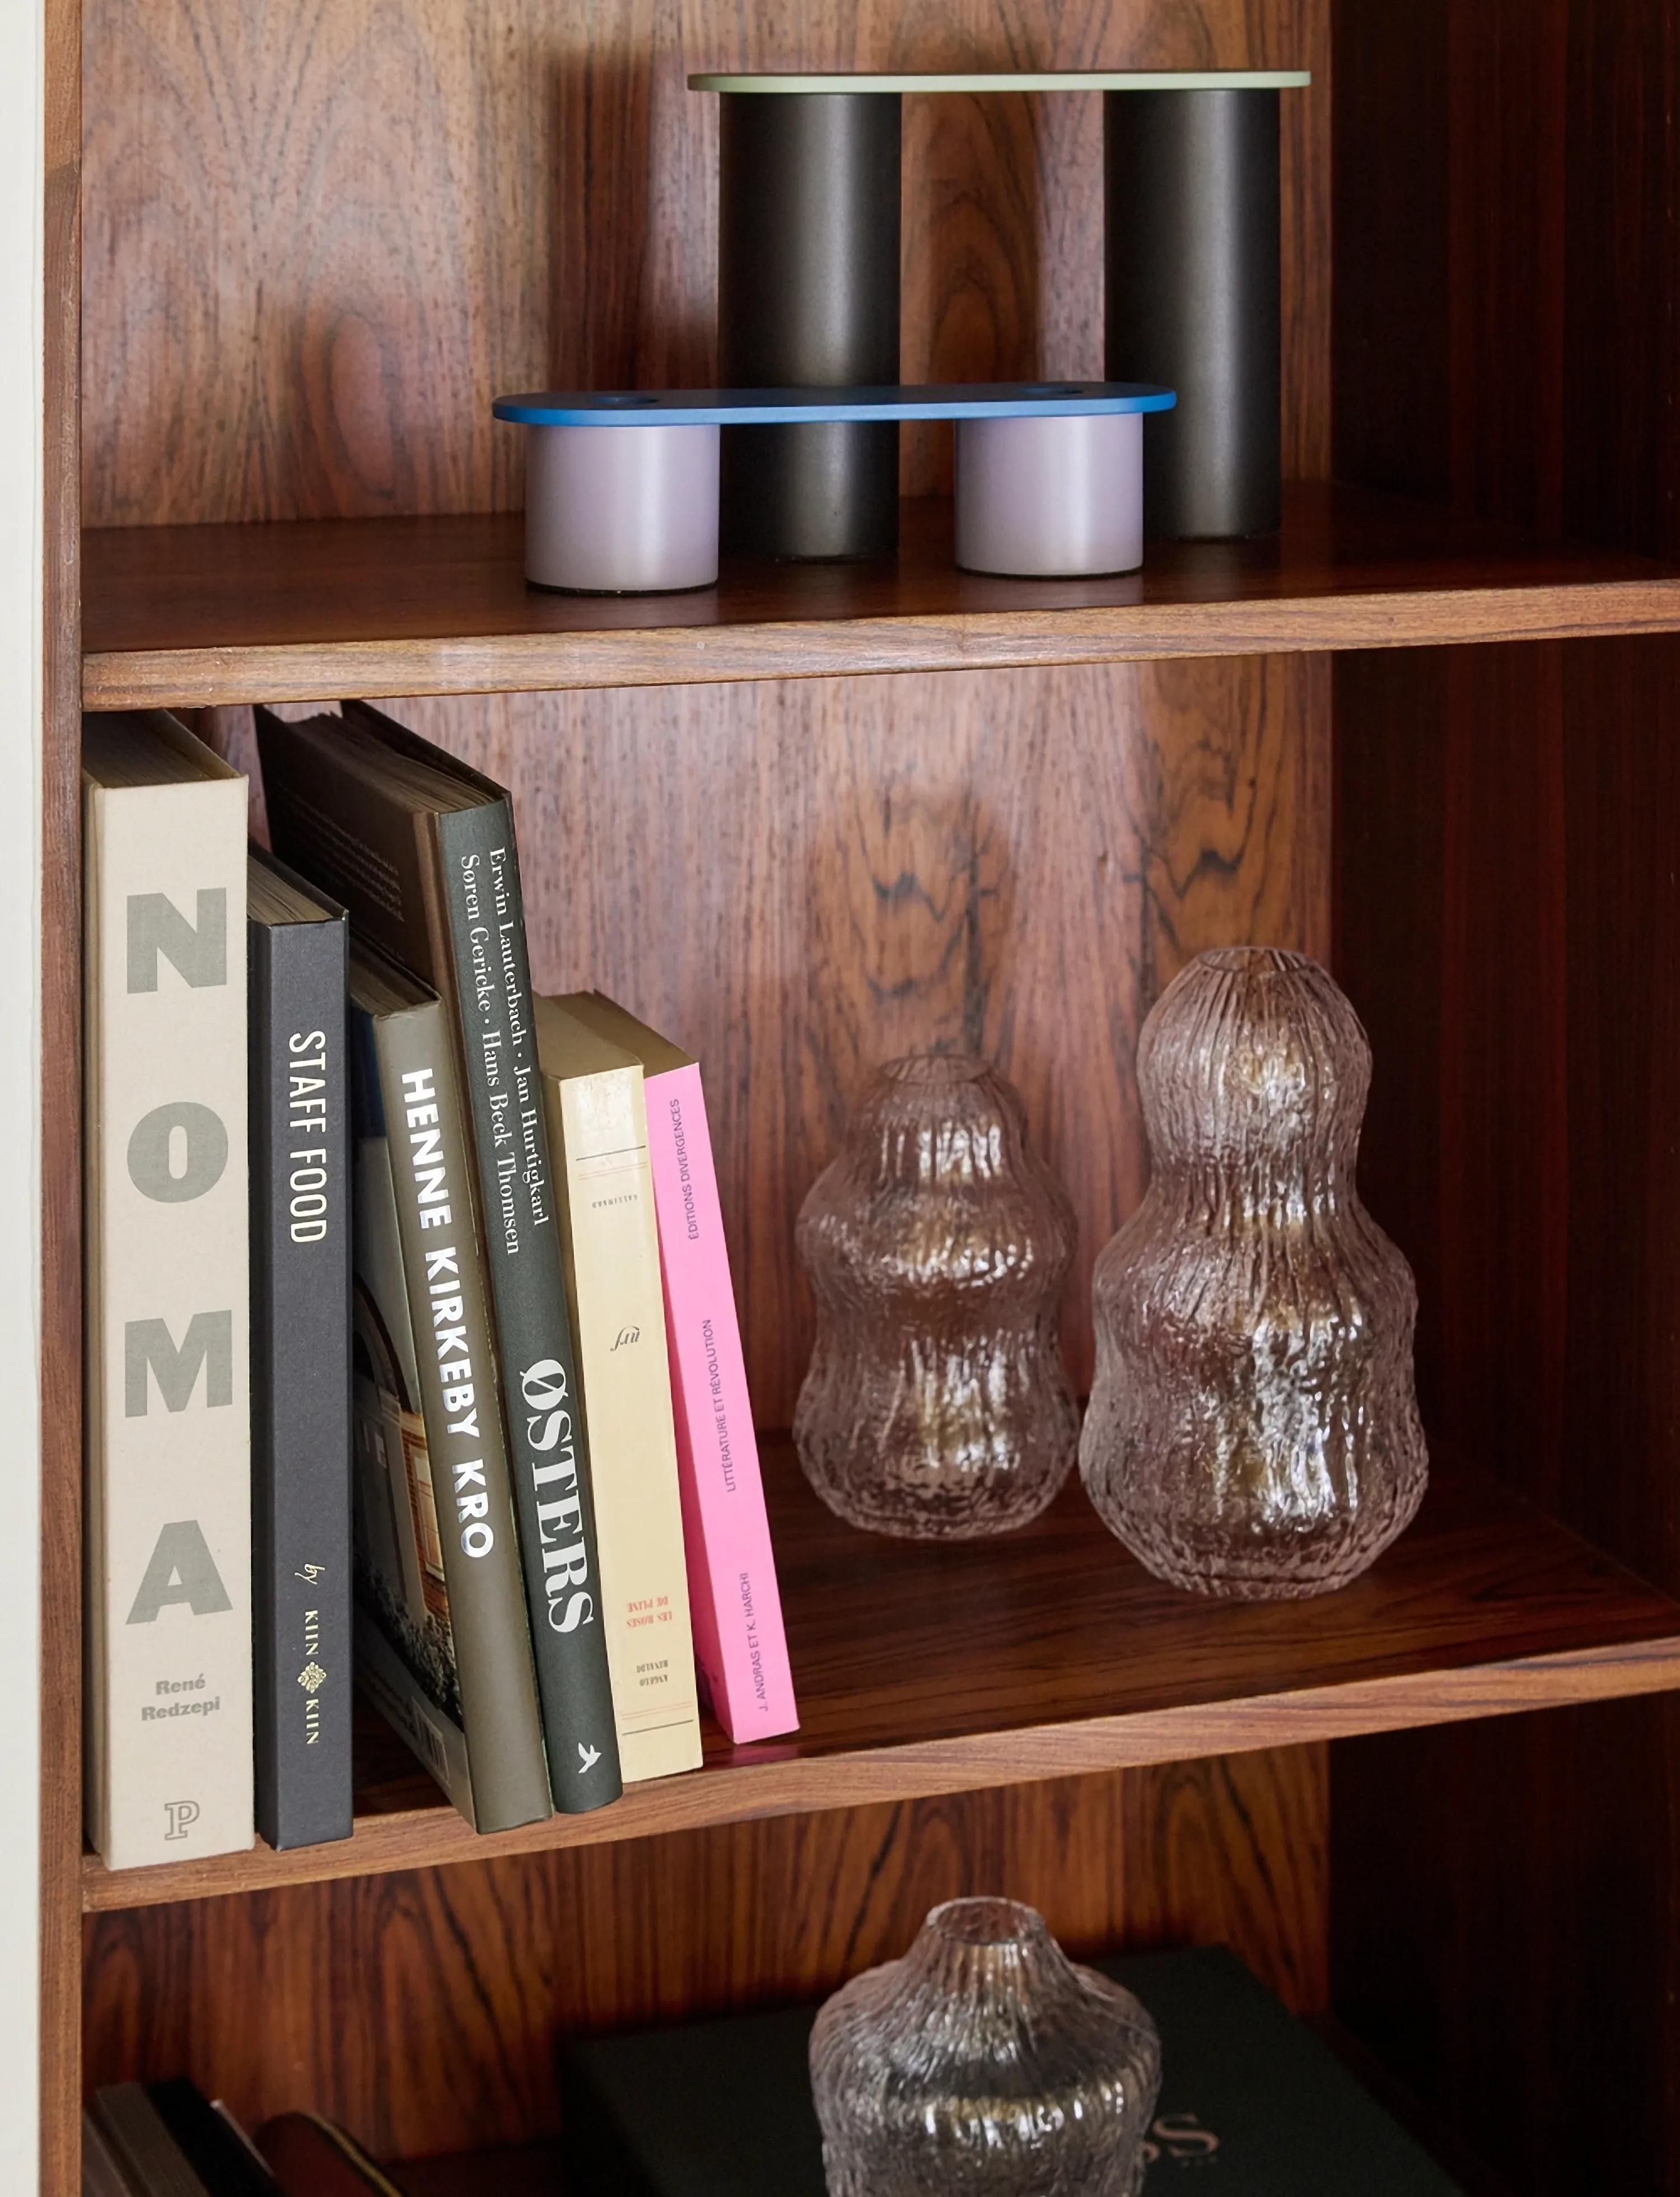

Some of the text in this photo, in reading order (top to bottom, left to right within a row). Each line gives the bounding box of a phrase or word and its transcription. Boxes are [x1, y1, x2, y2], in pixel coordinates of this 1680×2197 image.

[461, 854, 520, 1256] Søren Gericke Hans Beck Thomsen
[490, 846, 549, 1226] Erwin Lauterbach Jan Hurtigkarl
[289, 1030, 327, 1243] STAFF FOOD
[669, 1098, 690, 1182] DIVERGENCES
[125, 888, 231, 1625] NOMA
[402, 1068, 494, 1559] HENNE KIRKEBY KRO
[702, 1319, 736, 1493] LITTÉRATURE ET RÉVOLUTION
[519, 1359, 594, 1633] ØSTERS
[294, 1564, 325, 1585] by
[740, 1572, 754, 1618] HARCHI
[155, 1673, 206, 1696] René
[305, 1610, 319, 1744] KIIN KIIN
[748, 1634, 759, 1649] ET
[750, 1650, 767, 1700] ANDRAS
[141, 1695, 221, 1722] Redzepi
[164, 1800, 200, 1841] P
